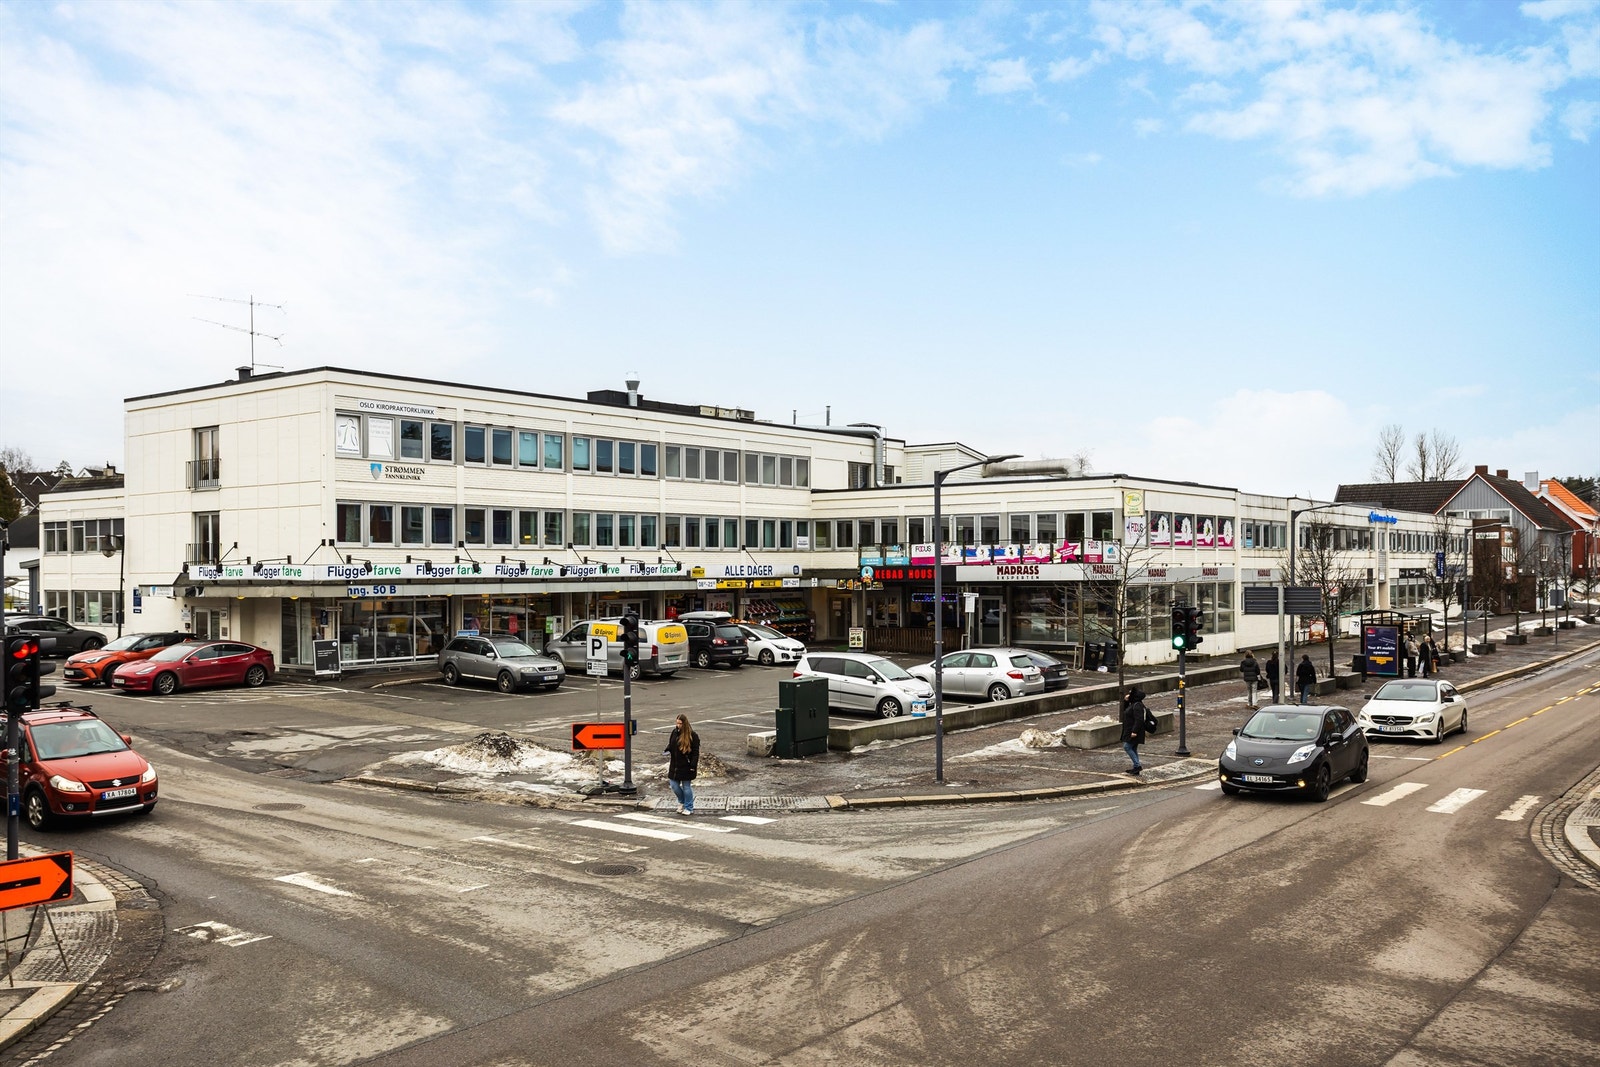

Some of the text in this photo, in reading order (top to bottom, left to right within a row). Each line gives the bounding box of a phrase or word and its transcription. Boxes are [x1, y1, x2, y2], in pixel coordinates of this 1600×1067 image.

[359, 401, 435, 415] OSLO KIROPRAKTORKLINIKK
[384, 466, 425, 475] STRØMMEN
[385, 473, 421, 481] TANNKLINIKK
[225, 567, 244, 577] farve
[282, 565, 302, 577] farve
[327, 564, 402, 578] Flügger farve
[531, 566, 554, 576] farve
[565, 565, 620, 577] Flügger frve
[659, 564, 678, 574] farve
[724, 565, 773, 576] ALLE DAGER
[875, 569, 937, 579] KEBAB HOUS
[996, 565, 1040, 576] MADRASS
[1092, 564, 1114, 575] MADRASS
[1147, 568, 1167, 578] MADRASS
[373, 586, 387, 595] 50
[389, 586, 397, 595] B
[592, 638, 602, 656] P
[117, 788, 135, 796] 17804
